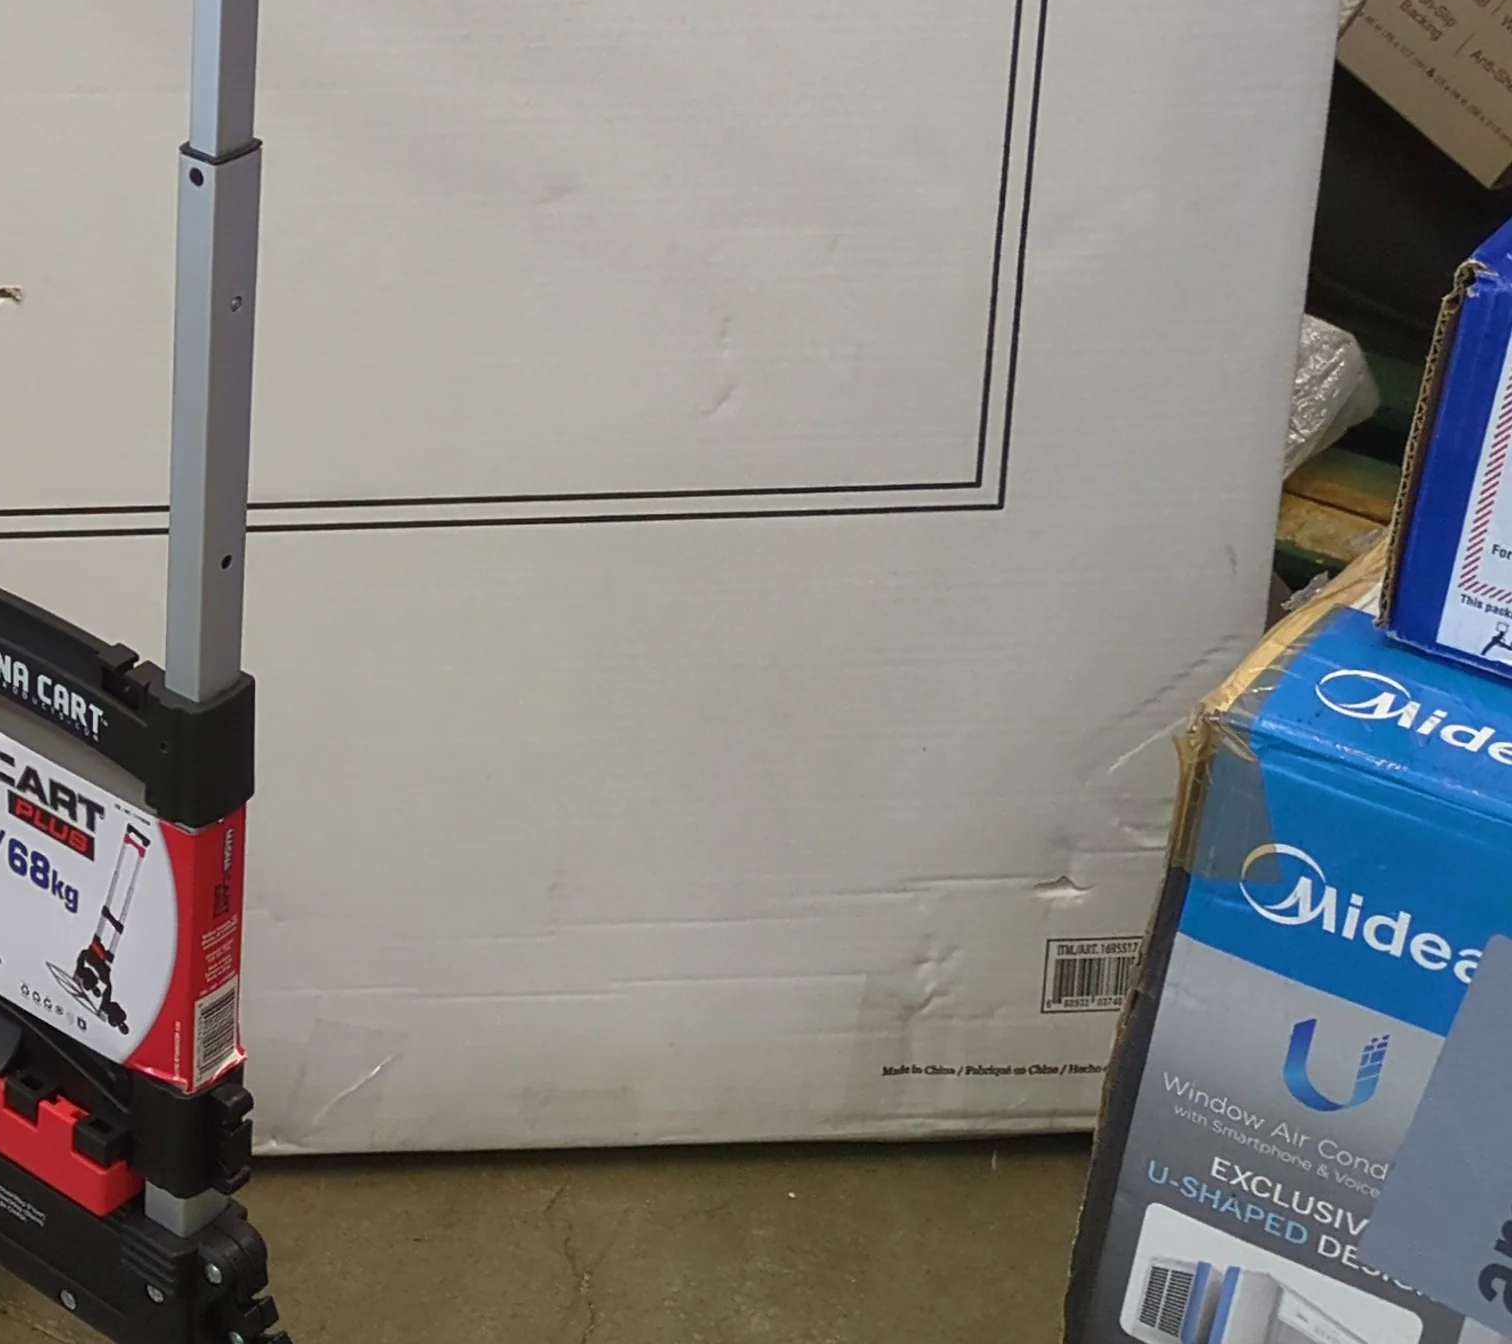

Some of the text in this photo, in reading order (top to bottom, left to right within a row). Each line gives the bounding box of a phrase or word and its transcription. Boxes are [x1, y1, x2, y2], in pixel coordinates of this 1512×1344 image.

[1460, 593, 1483, 609] This
[37, 674, 104, 735] CART
[14, 798, 90, 854] PLUS
[1163, 1072, 1265, 1130] Window
[1270, 1122, 1309, 1150] Air
[1173, 1104, 1381, 1199] with Smartphone & Voice
[1147, 1160, 1309, 1244] U-SHAPED
